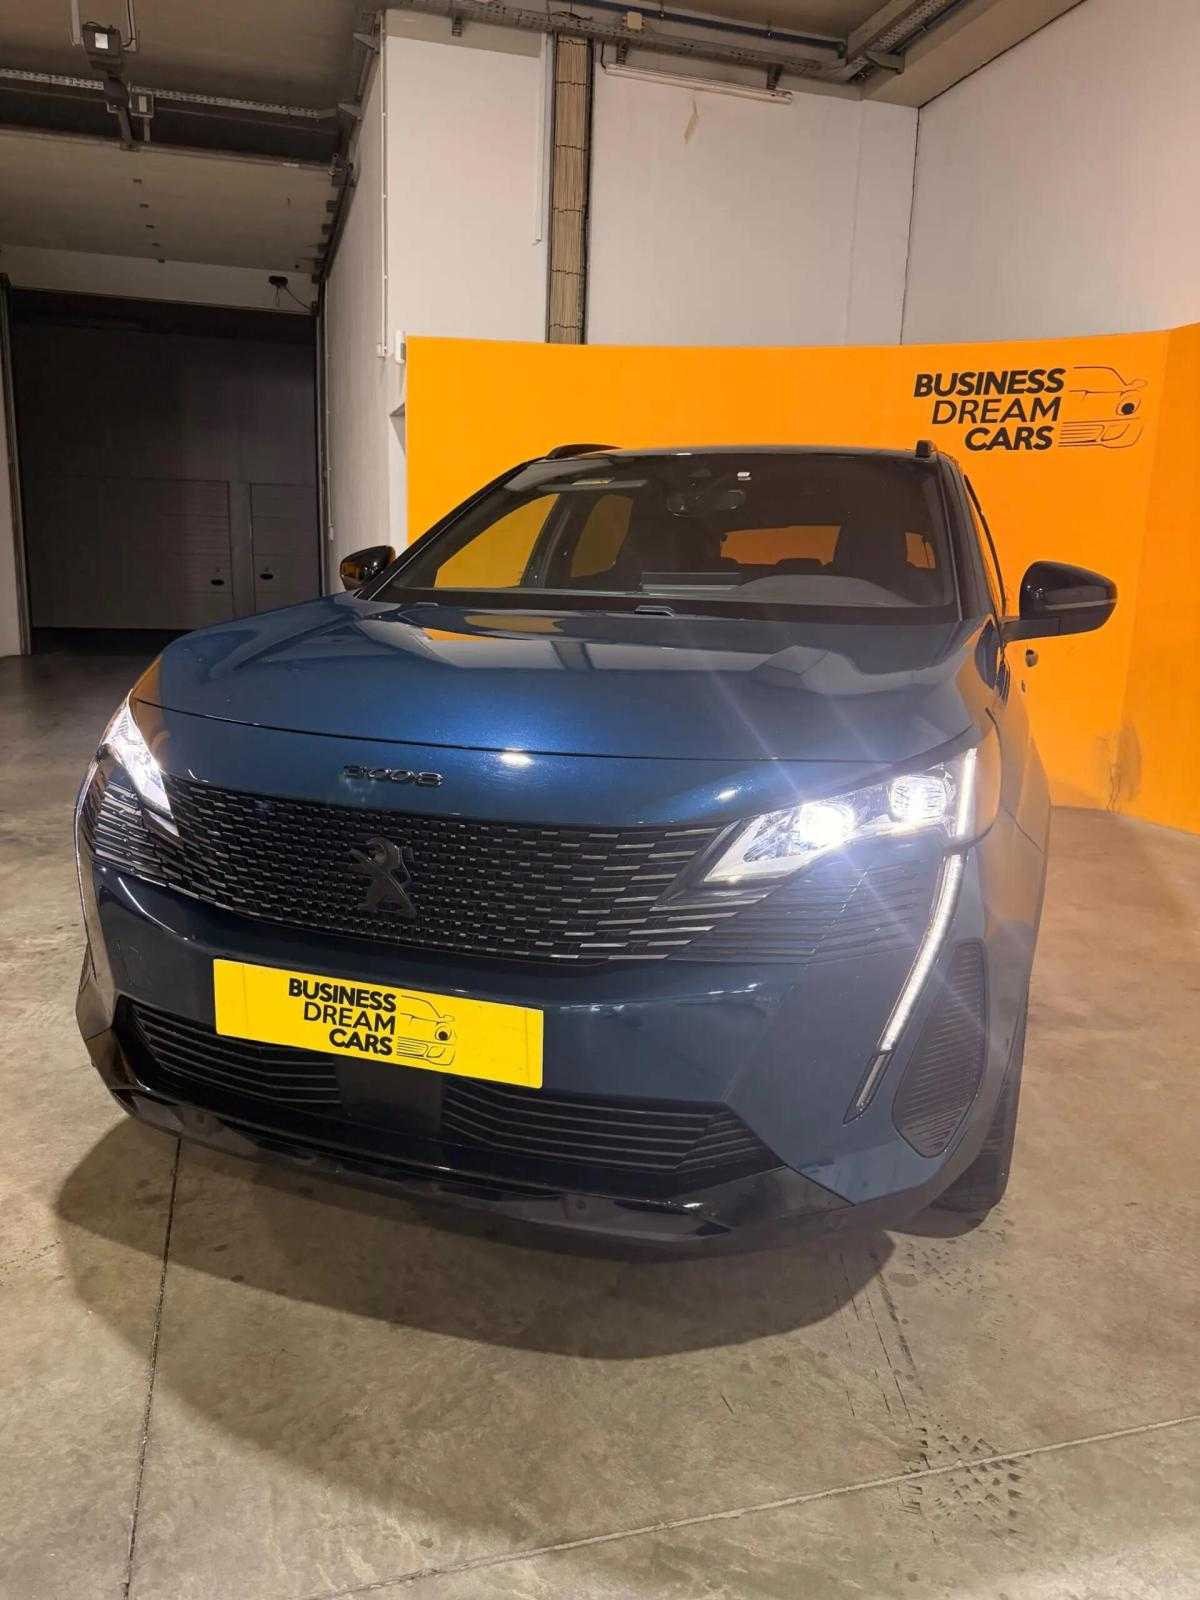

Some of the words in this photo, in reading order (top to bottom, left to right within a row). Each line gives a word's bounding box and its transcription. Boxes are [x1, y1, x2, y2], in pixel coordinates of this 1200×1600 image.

[914, 369, 1066, 397] BUSINESS
[933, 398, 1061, 424] DREAM
[965, 427, 1053, 450] CARS
[288, 978, 396, 1012] BUSINESS
[303, 1002, 395, 1035] DREAM
[328, 1028, 393, 1056] CARS
